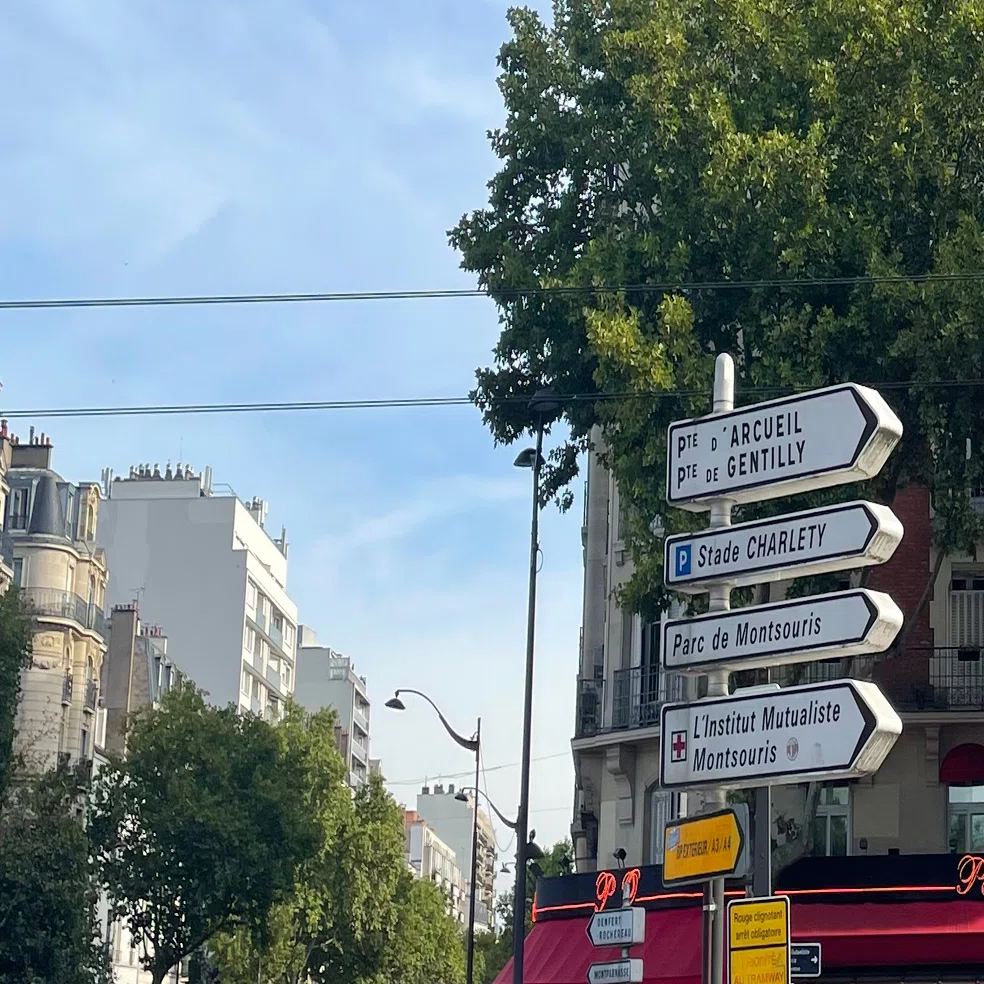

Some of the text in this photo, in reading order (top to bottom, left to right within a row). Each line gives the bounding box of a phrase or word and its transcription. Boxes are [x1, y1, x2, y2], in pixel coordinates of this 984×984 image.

[706, 467, 719, 483] DE
[727, 440, 806, 478] GENTILLY
[698, 540, 740, 568] Stade
[746, 523, 827, 559] CHARLETY
[673, 612, 822, 657] Parc de Montsouris
[693, 700, 841, 739] L'Institut Mutualiste
[693, 740, 777, 772] Montsouris
[597, 916, 621, 928] DENFERT
[734, 910, 783, 925] Rouge clignotant
[736, 928, 782, 941] arrêt obligatoire
